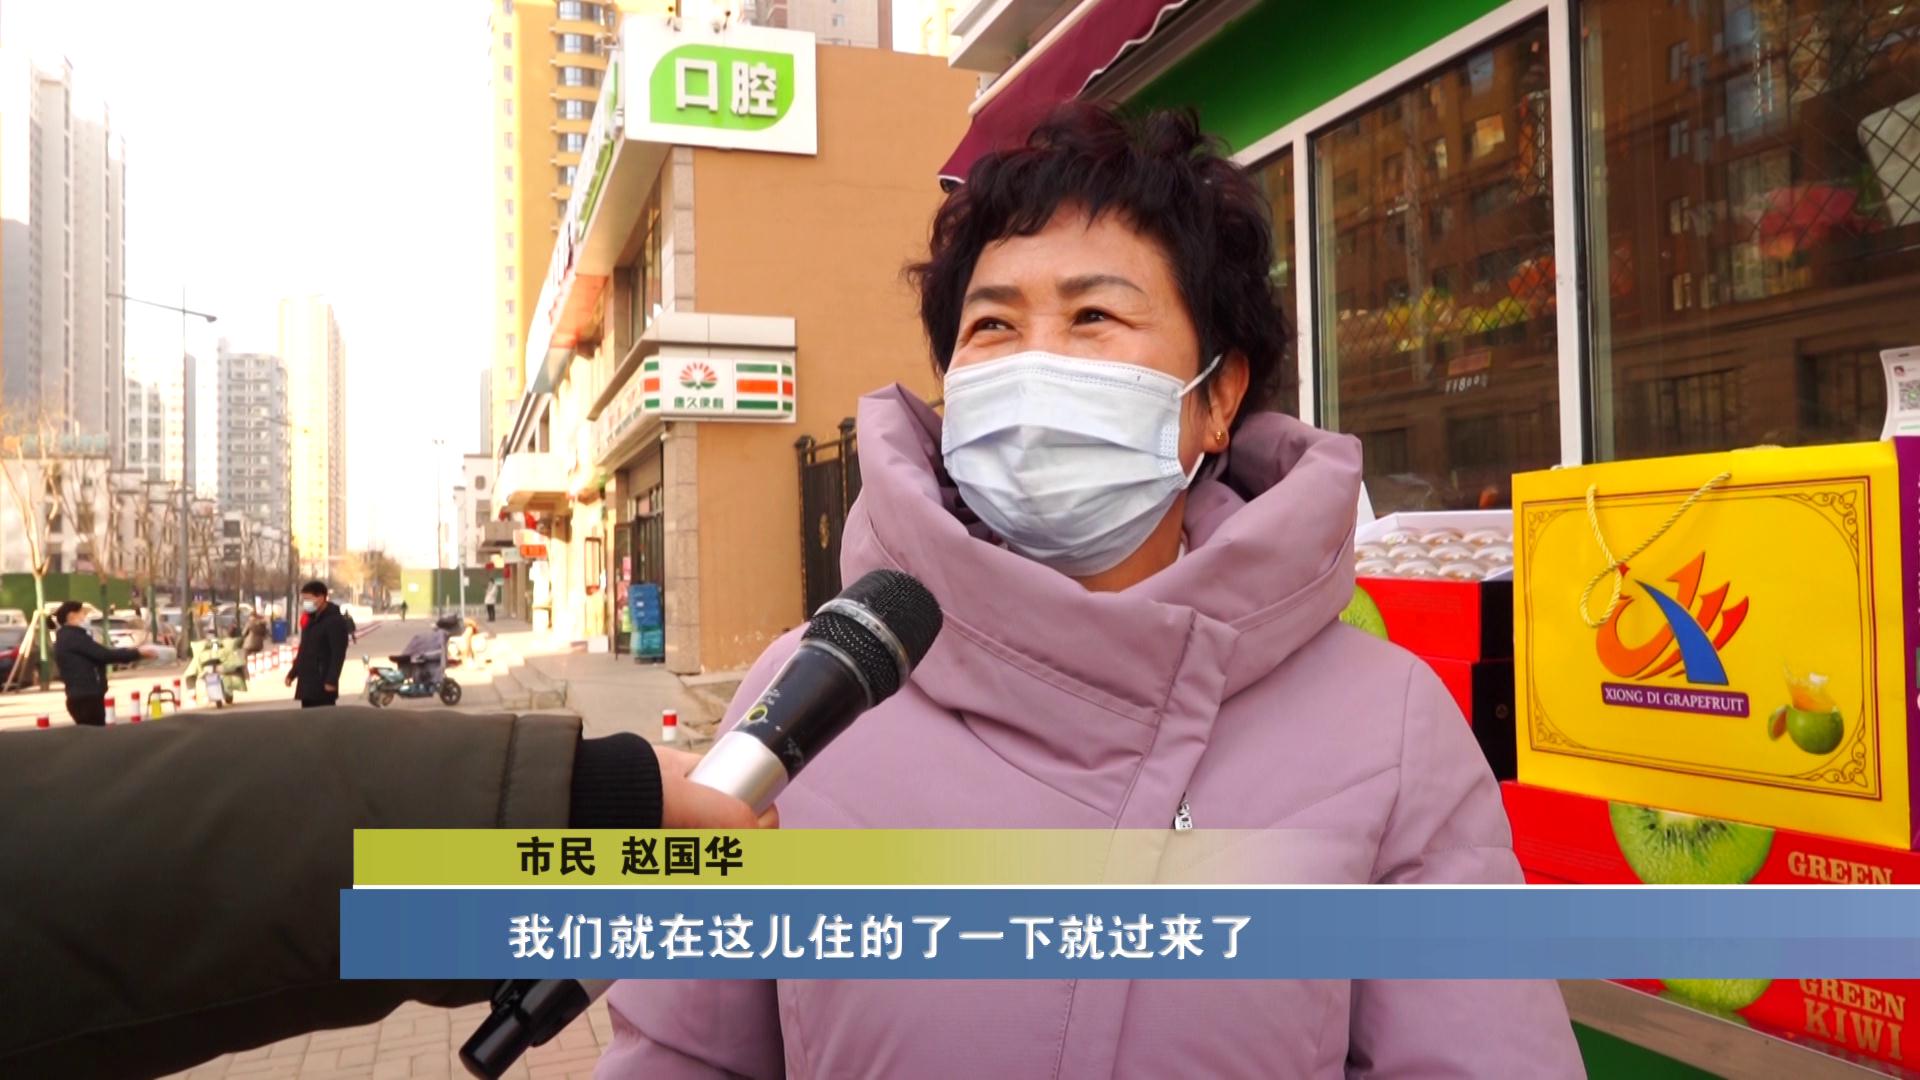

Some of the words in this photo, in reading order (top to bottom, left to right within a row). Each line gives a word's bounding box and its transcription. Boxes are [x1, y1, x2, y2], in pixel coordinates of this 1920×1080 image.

[675, 57, 778, 117] 口腔
[1604, 687, 1644, 704] XIONG
[1647, 691, 1660, 705] DI
[1663, 693, 1745, 712] GRAPEFRUIT
[1787, 850, 1893, 885] GREEN
[1799, 978, 1906, 1020] GREEN
[1803, 1000, 1904, 1061] KIWI
